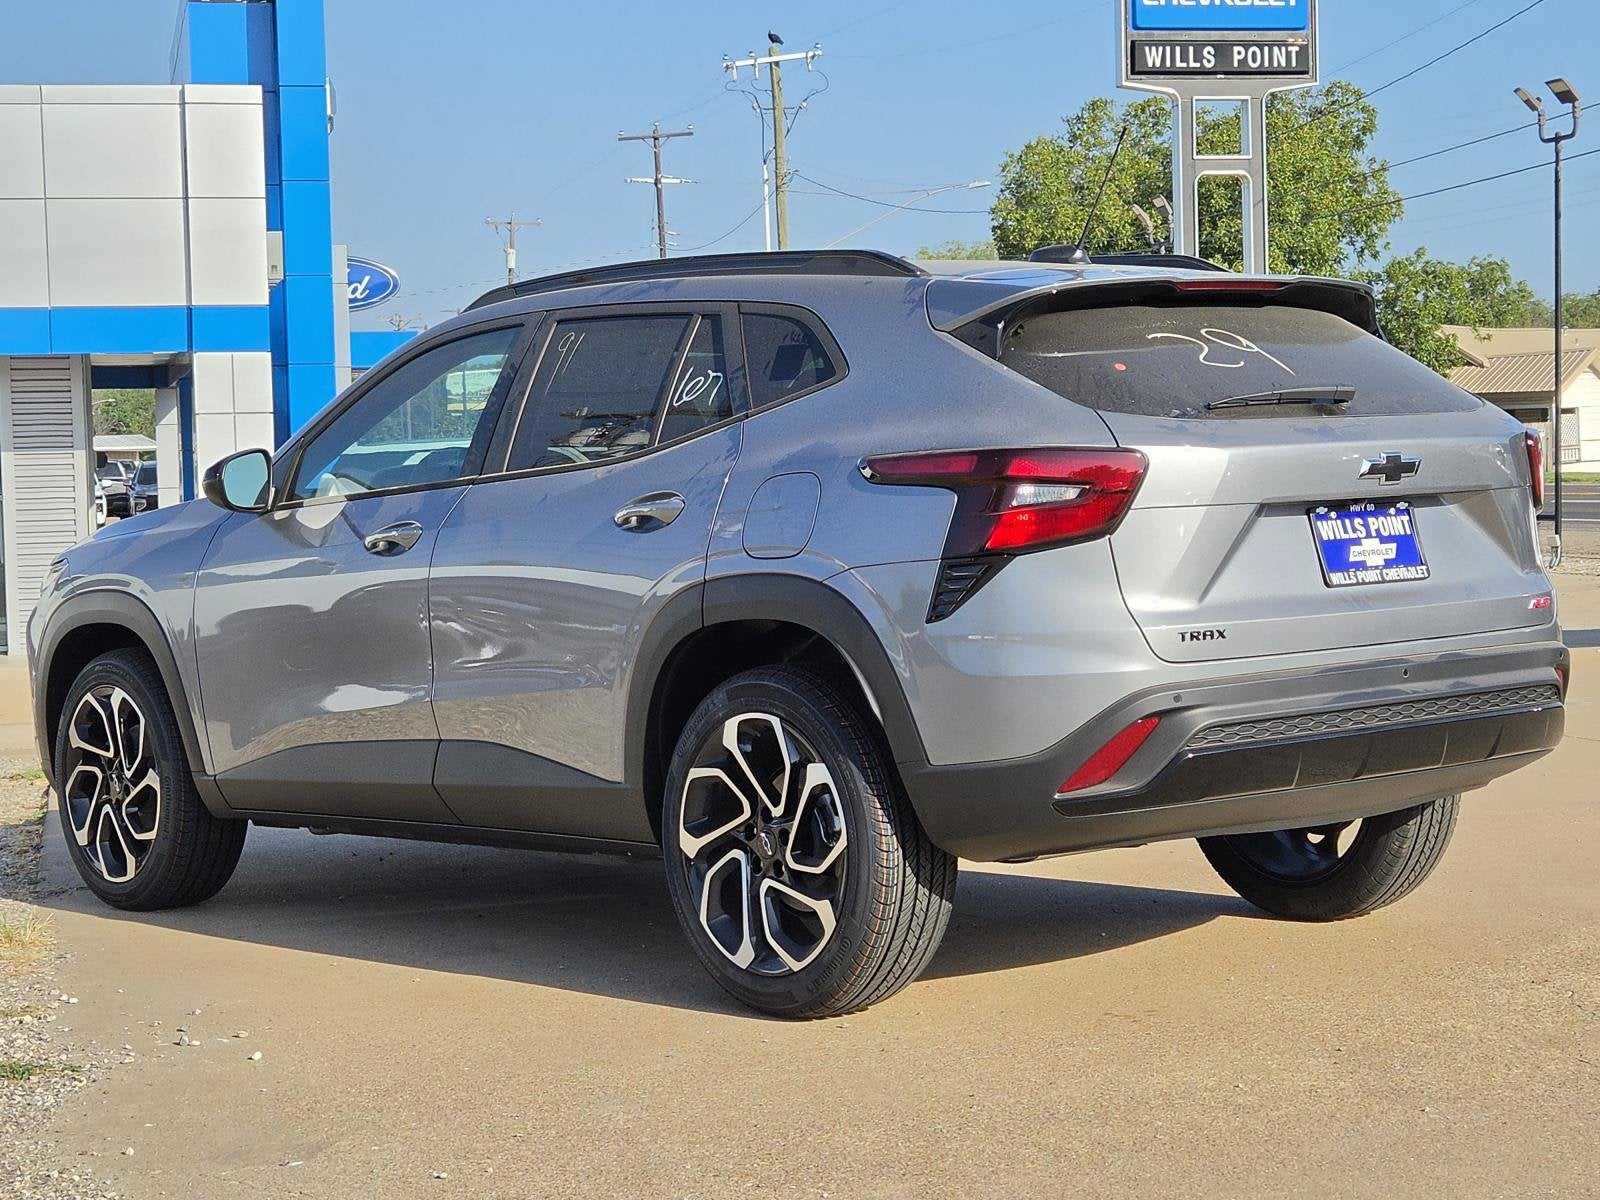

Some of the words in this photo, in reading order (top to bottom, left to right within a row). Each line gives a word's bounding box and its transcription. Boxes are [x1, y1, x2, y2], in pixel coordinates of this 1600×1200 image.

[1144, 45, 1216, 69] WILLS
[1233, 45, 1300, 69] POINT
[1316, 517, 1366, 541] WILLS
[1367, 515, 1412, 537] POINT
[1351, 547, 1395, 558] CHEVROLET
[1329, 571, 1357, 585] WILLS
[1357, 569, 1383, 583] POINT
[1383, 565, 1429, 581] CHEVROLET
[1177, 628, 1227, 643] TRAX
